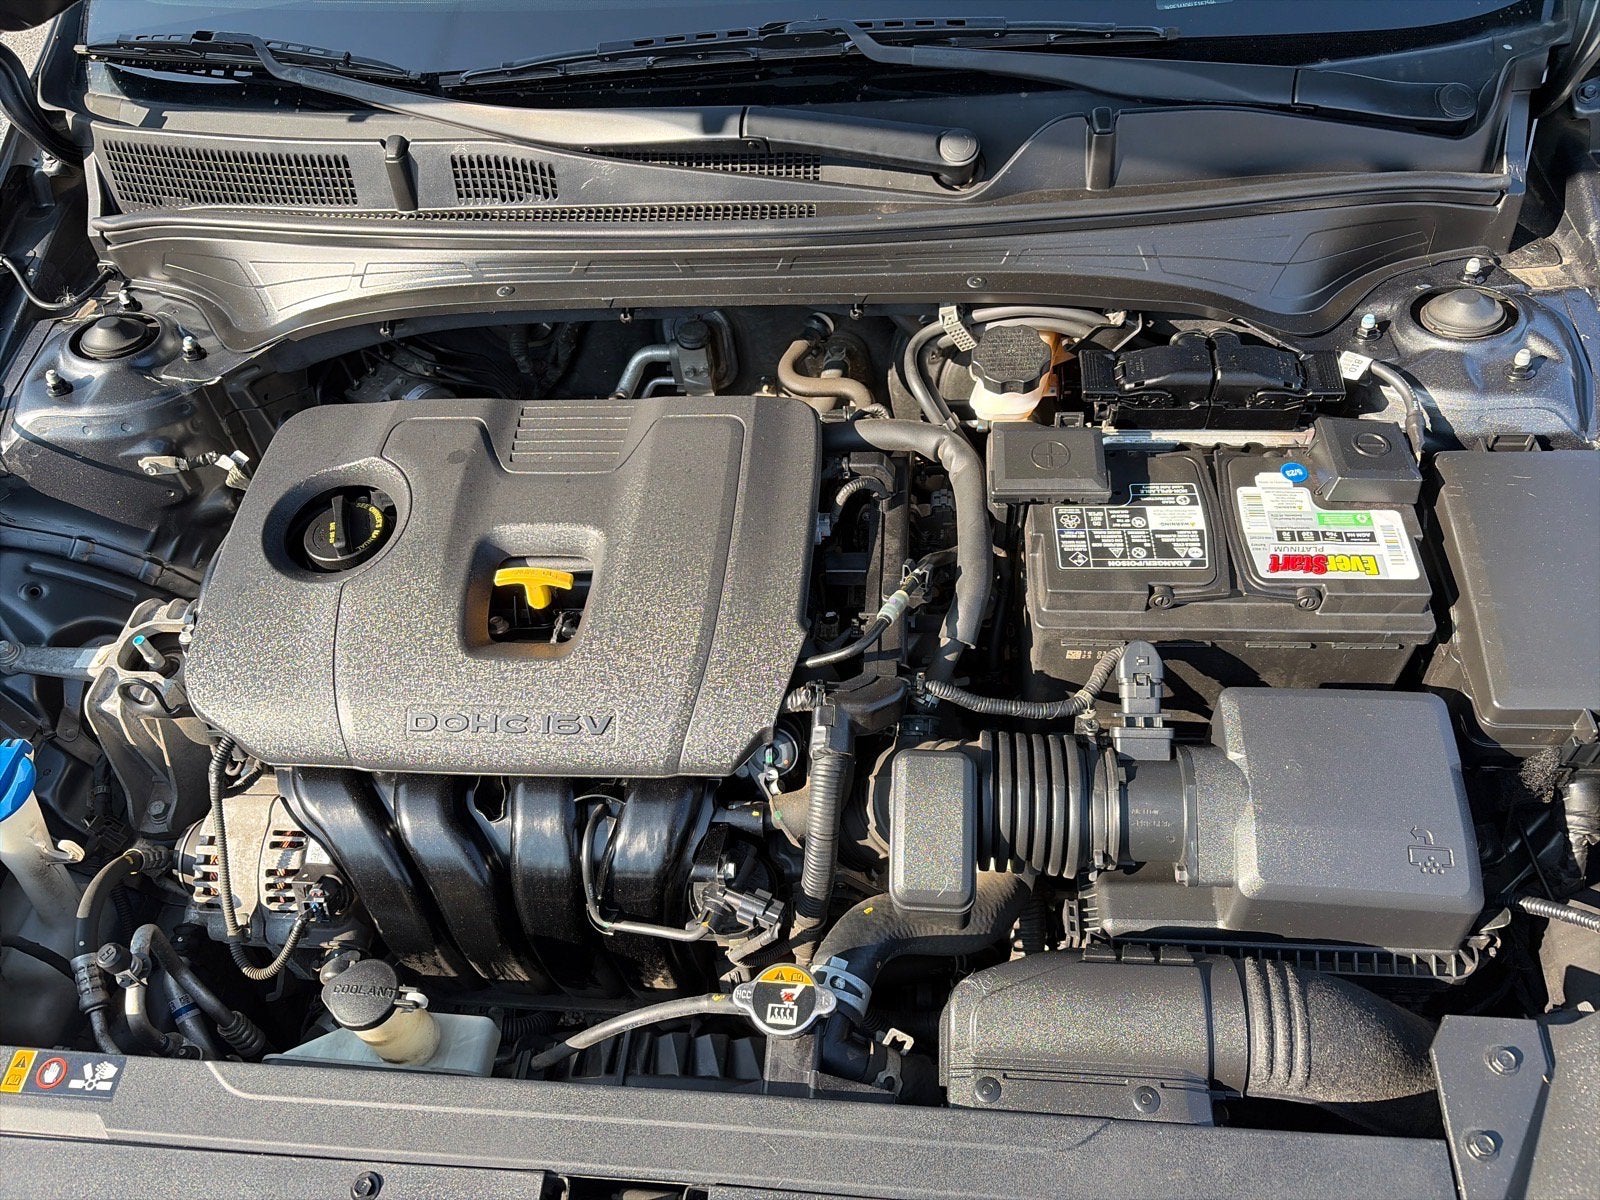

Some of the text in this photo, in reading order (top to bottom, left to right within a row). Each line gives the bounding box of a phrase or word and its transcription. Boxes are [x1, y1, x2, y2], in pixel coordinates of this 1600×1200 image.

[1269, 554, 1380, 576] EverStart
[409, 713, 614, 736] DOHC 16V
[333, 984, 396, 998] COOLANT
[735, 989, 752, 1000] HCC
